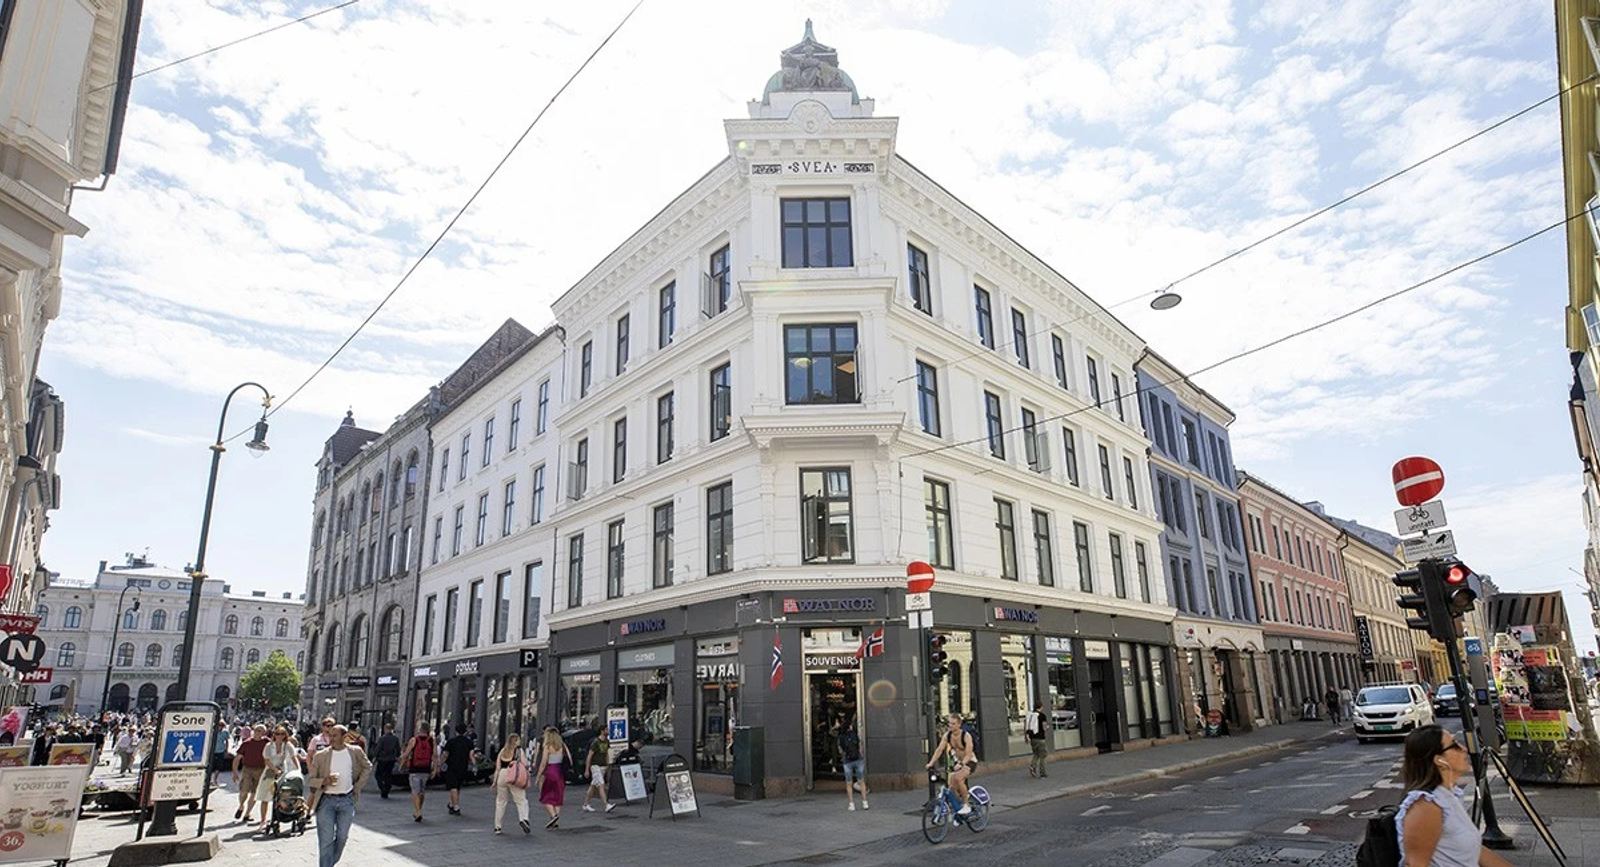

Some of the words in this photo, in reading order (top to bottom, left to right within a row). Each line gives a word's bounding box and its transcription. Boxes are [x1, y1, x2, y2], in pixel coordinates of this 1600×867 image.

[627, 619, 665, 634] WAYNOR
[1357, 617, 1371, 655] TATTOO
[7, 639, 36, 661] N
[805, 655, 859, 666] SOUVENIRS
[172, 714, 206, 726] Sone
[13, 780, 70, 791] YOGHURT
